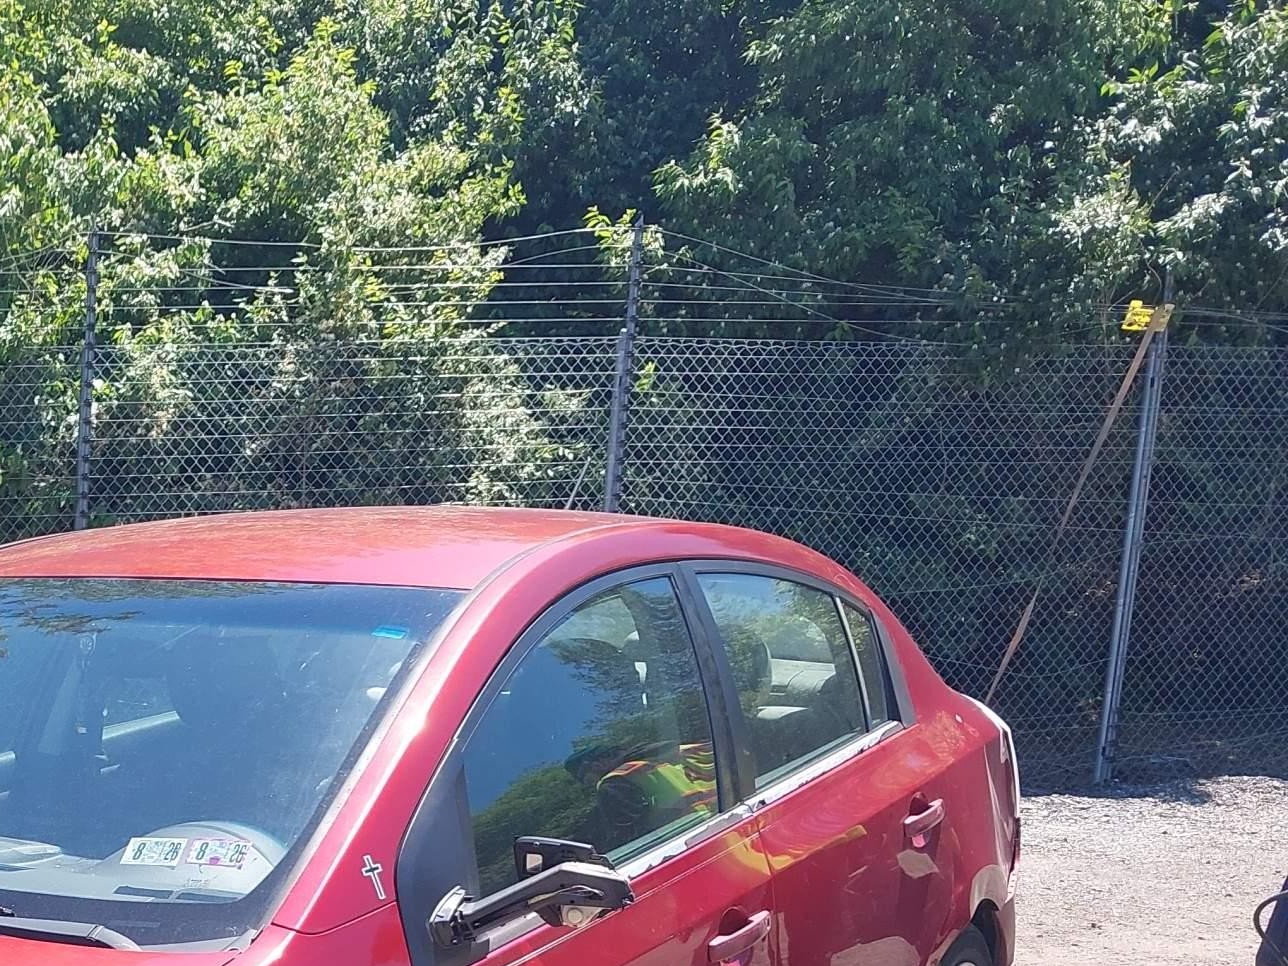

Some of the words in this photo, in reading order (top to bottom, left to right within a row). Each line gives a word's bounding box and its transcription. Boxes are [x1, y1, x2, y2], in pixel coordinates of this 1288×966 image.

[132, 842, 146, 860] 8
[195, 842, 210, 860] 8
[228, 844, 247, 863] 26
